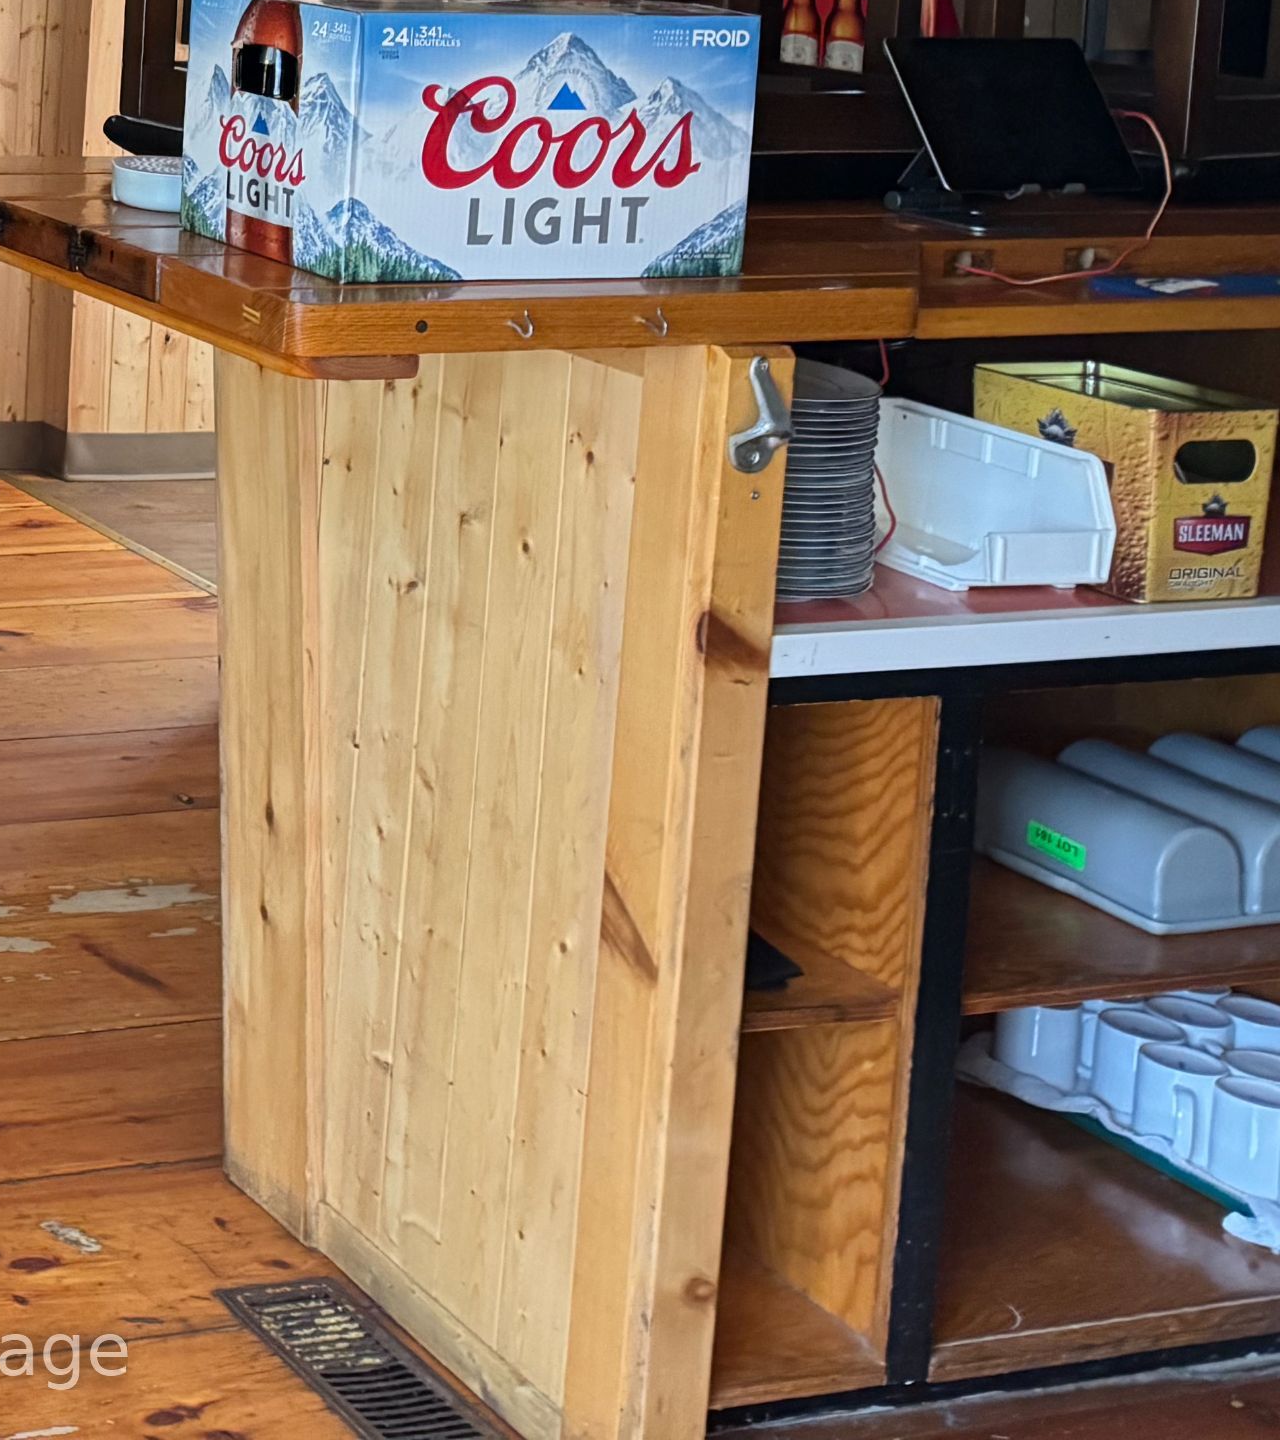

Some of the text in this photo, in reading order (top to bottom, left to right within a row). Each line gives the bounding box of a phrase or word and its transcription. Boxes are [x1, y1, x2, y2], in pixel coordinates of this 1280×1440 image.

[311, 20, 328, 38] 24
[381, 26, 410, 47] 24
[691, 28, 751, 48] FROID
[413, 38, 462, 48] BOUTEILLES
[420, 75, 702, 190] Coors
[218, 113, 307, 187] Coors
[225, 168, 296, 219] LIGHT
[465, 196, 650, 246] LIGHT
[1177, 521, 1246, 544] SLEEMAN
[1168, 566, 1246, 581] ORIGINAL
[1055, 838, 1079, 858] LOT
